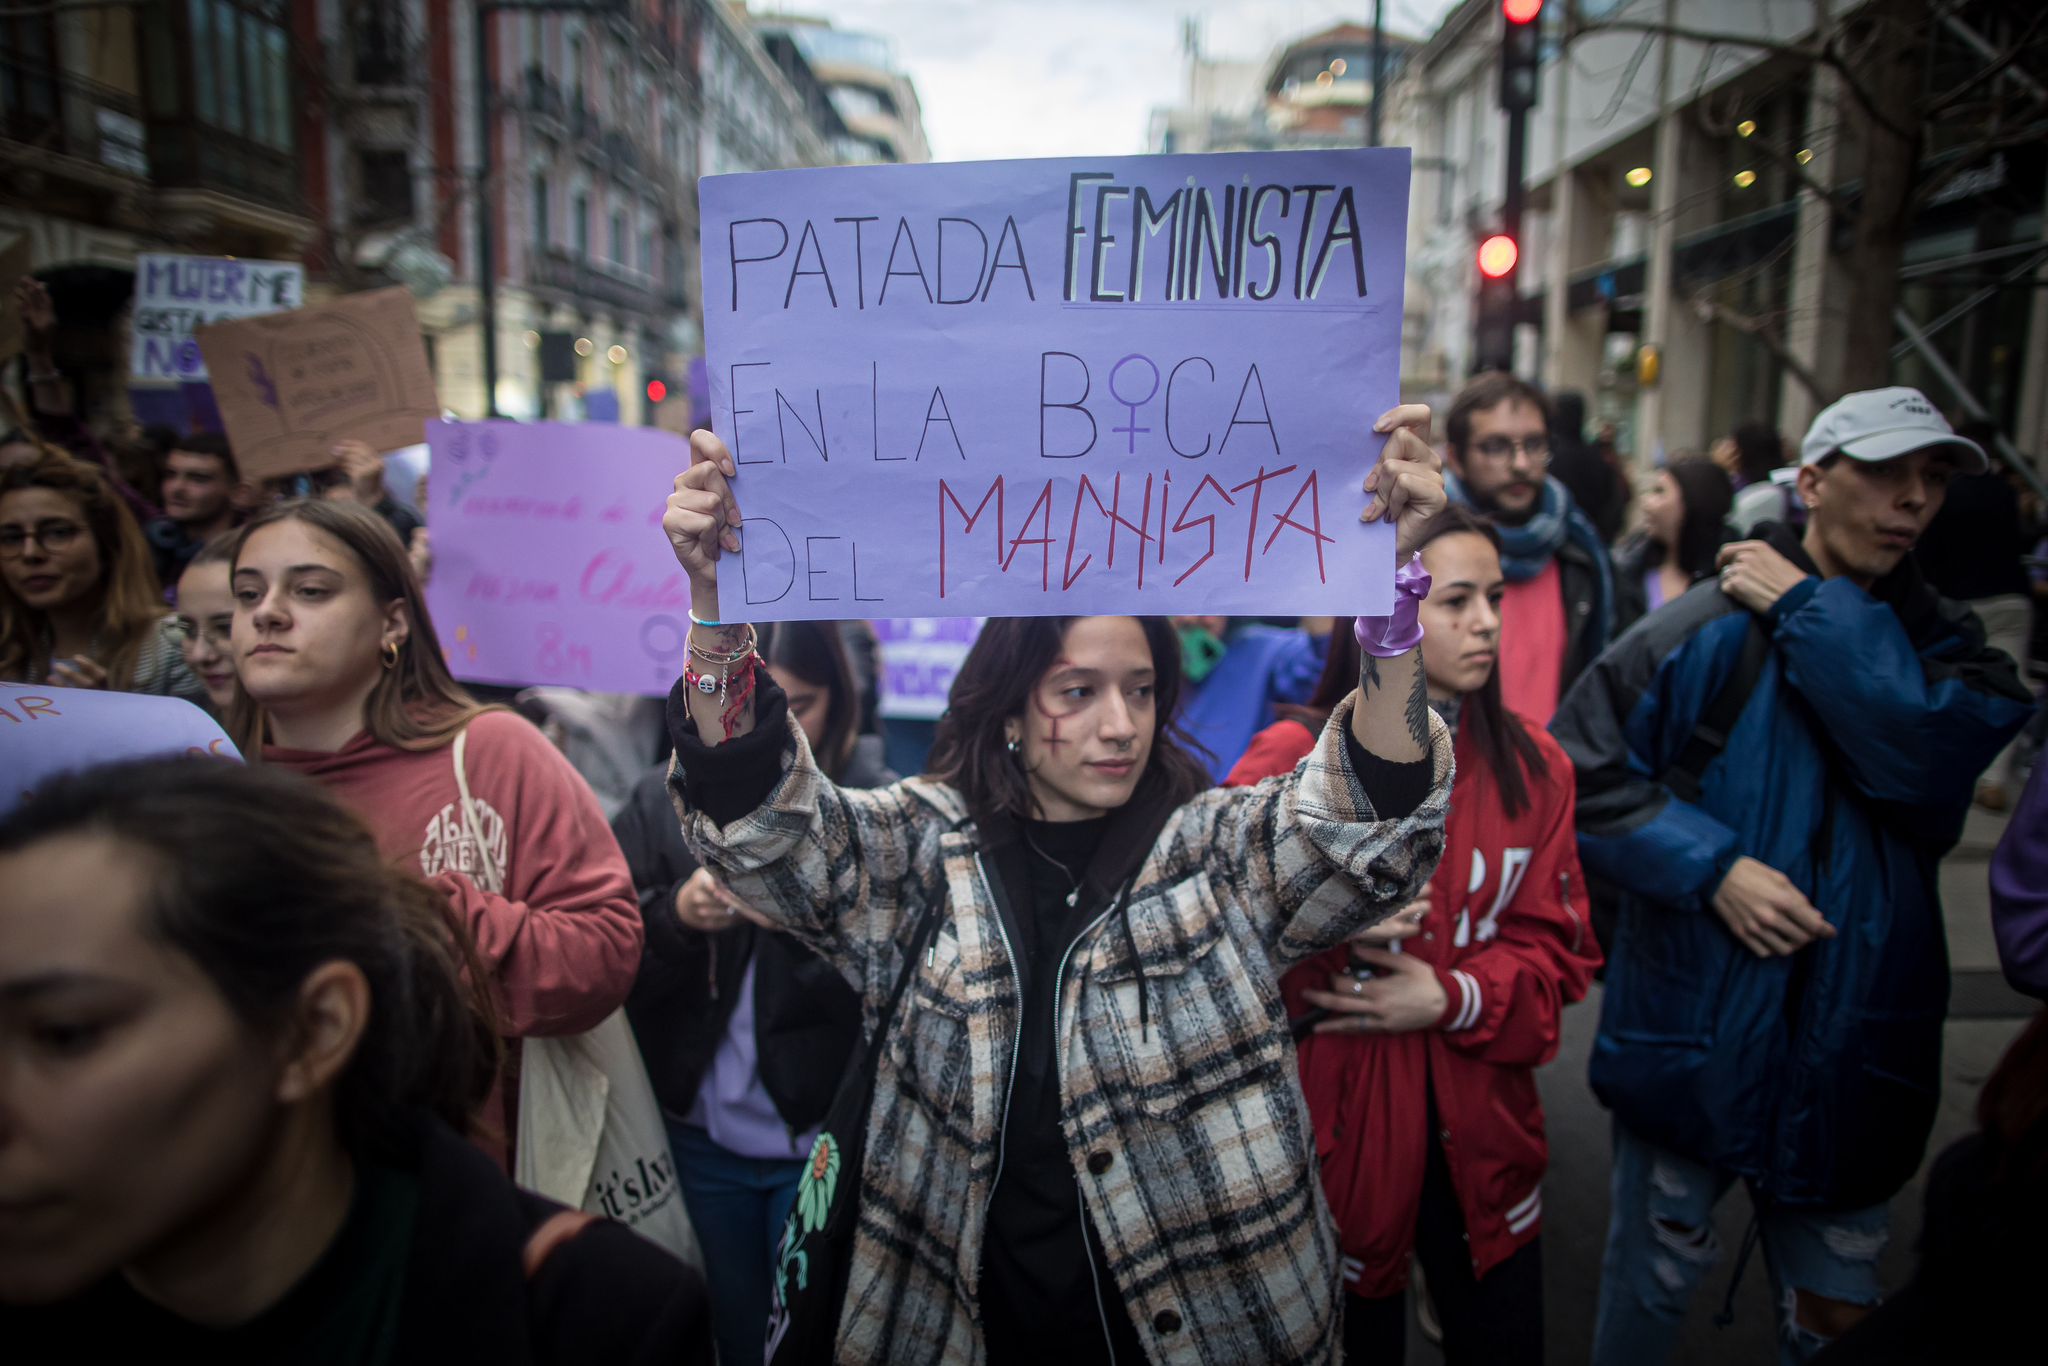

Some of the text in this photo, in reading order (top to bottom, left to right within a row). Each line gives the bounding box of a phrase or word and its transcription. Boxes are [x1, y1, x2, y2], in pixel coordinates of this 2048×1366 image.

[250, 268, 299, 310] ME
[729, 172, 1368, 312] PATADA FEMINISTA
[731, 362, 829, 465] EN
[873, 361, 966, 461] LA
[740, 518, 884, 605] DEL
[939, 465, 1336, 599] MACHISTA
